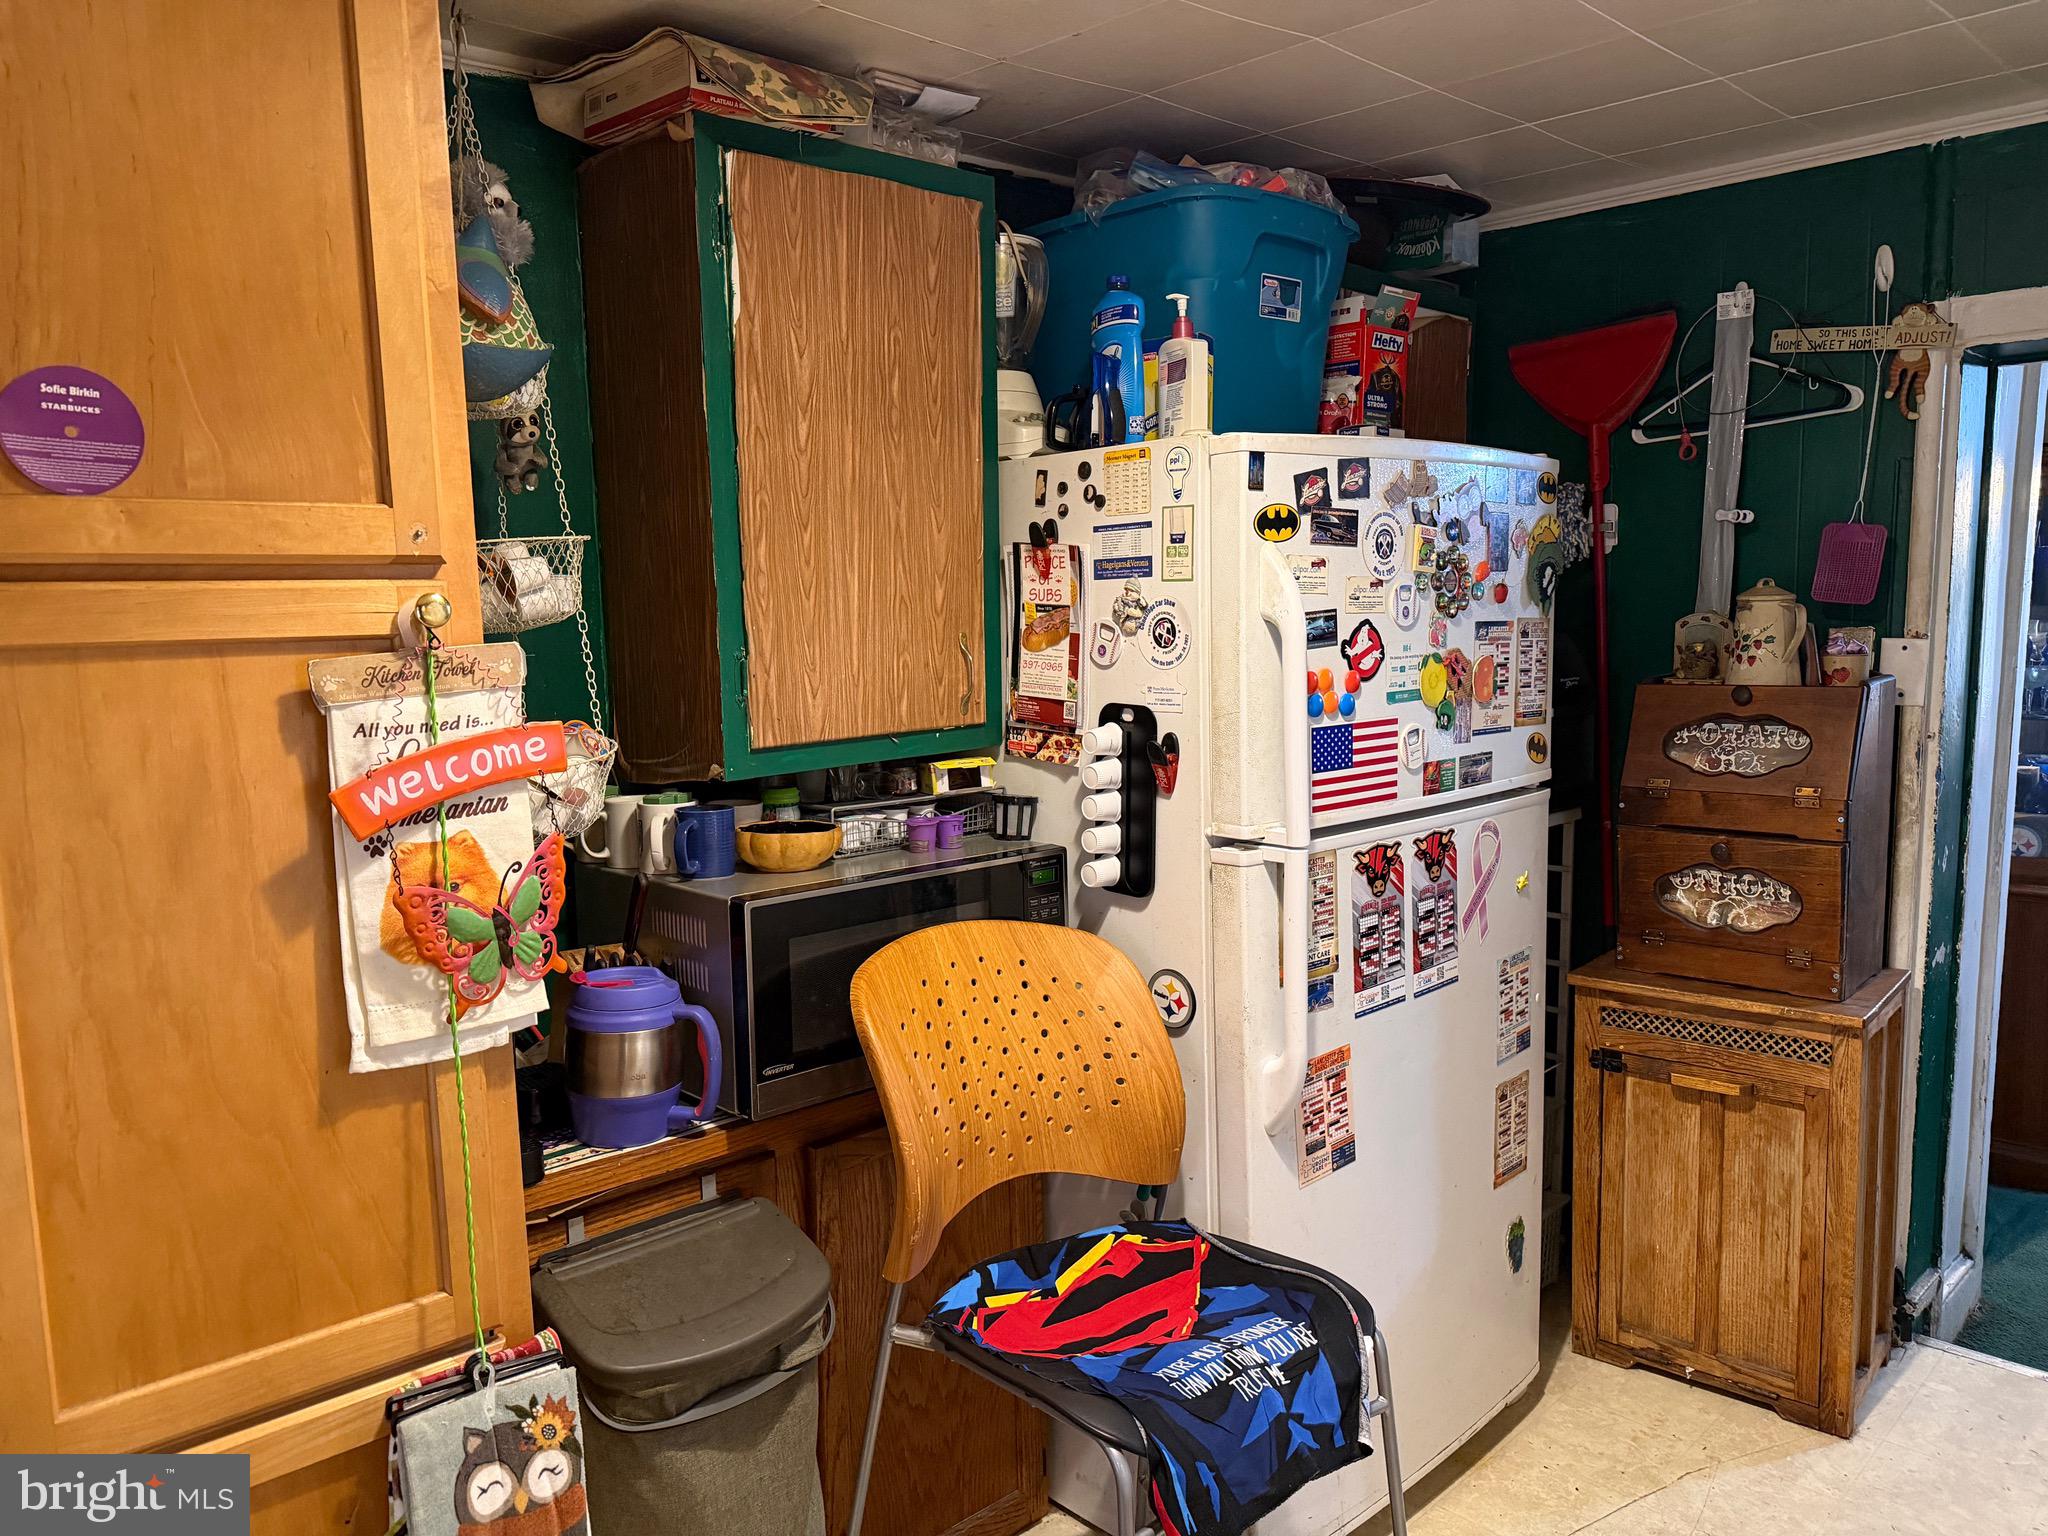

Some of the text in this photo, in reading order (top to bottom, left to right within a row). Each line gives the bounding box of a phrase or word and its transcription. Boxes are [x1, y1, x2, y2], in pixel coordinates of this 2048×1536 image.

[1396, 235, 1440, 257] Kleenex
[1819, 329, 1830, 338] SO
[1836, 329, 1857, 338] THIS
[1894, 331, 1952, 345] ADJUST!
[1374, 333, 1402, 352] Hefty
[1776, 340, 1803, 350] HOME
[1807, 339, 1844, 350] SWEET
[40, 383, 100, 398] Sofie Birkin
[1367, 394, 1385, 402] ULTRA
[41, 402, 101, 414] STARBUCKS
[1366, 401, 1388, 410] STRONG
[1170, 455, 1180, 465] ppl
[1029, 588, 1063, 602] SUBS
[361, 655, 476, 689] Kitchen Towel
[1022, 660, 1063, 672] 397-0965
[352, 722, 379, 739] All
[382, 722, 414, 741] you
[765, 1064, 795, 1076] INVERTER
[1311, 1156, 1330, 1169] URGENT
[1312, 1164, 1324, 1175] CARE
[1187, 1340, 1231, 1362] MUCH
[1220, 1316, 1293, 1349] STRONGER
[1169, 1321, 1319, 1400] THAN YOU THINK YOU ARE
[1229, 1362, 1291, 1402] TRUST ME
